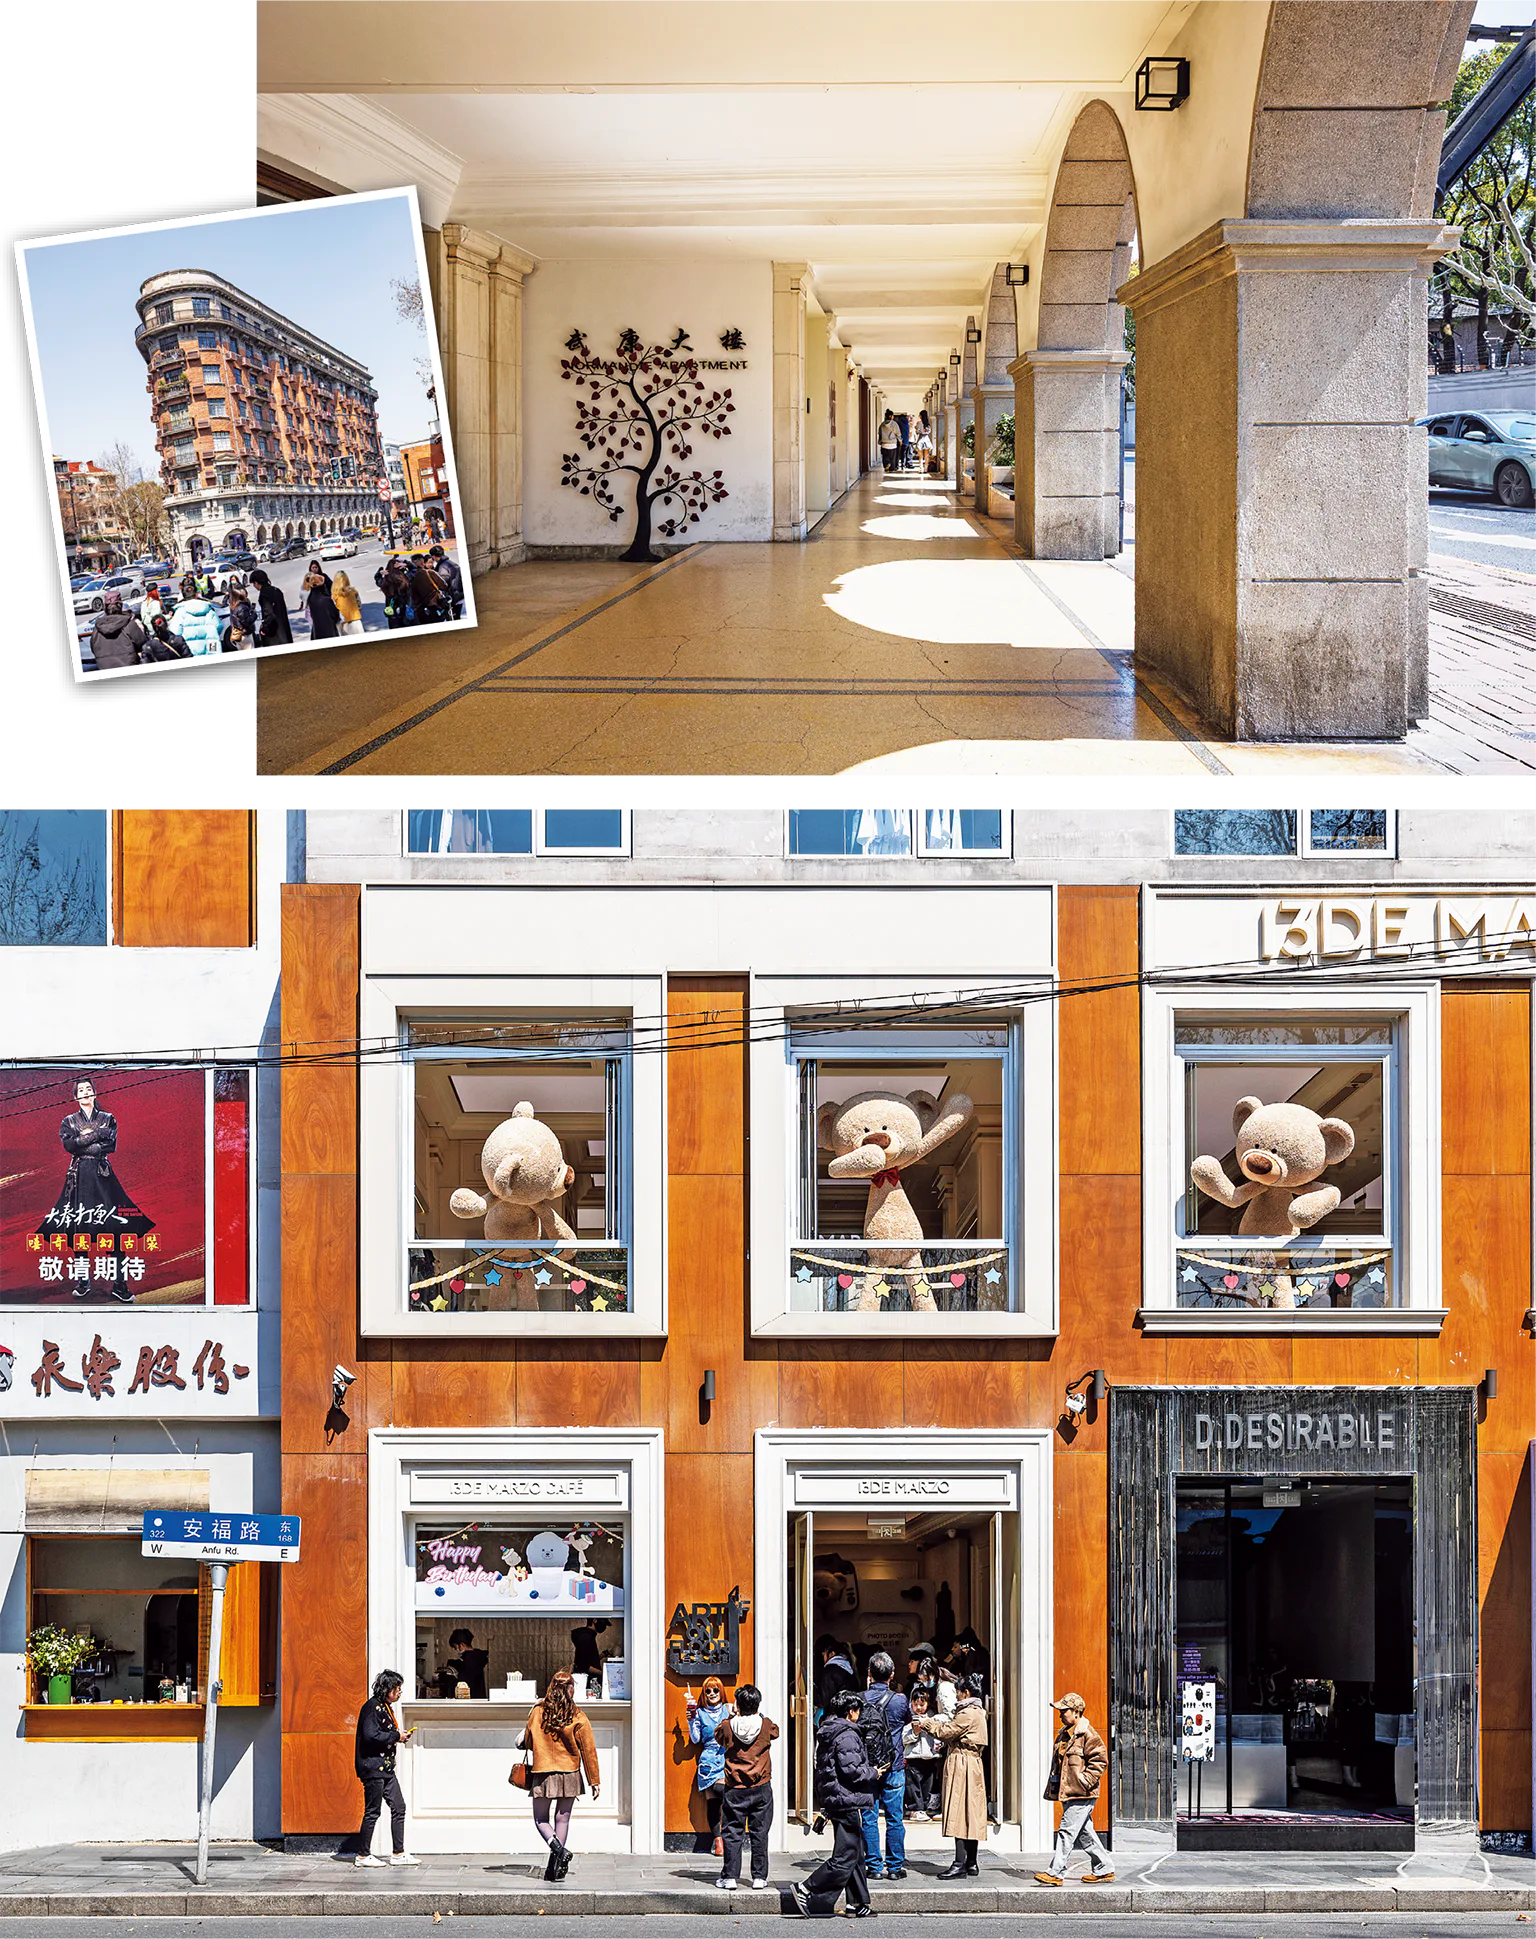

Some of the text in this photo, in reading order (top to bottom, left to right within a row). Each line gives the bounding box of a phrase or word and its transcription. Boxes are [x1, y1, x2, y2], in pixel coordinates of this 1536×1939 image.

[567, 360, 748, 371] ORMANDE APARTMENT
[38, 1256, 146, 1281] 敬请期待
[1195, 1412, 1396, 1450] D.DESIRABLE
[487, 1482, 541, 1495] MARZO
[546, 1478, 584, 1495] CAFÉ
[895, 1481, 949, 1494] MARZO
[183, 1518, 261, 1541] 安福路
[280, 1521, 292, 1533] 东
[149, 1530, 165, 1539] 322
[277, 1535, 293, 1543] 168
[150, 1544, 163, 1554] W
[201, 1546, 240, 1556] Anfu Rd.
[280, 1549, 288, 1559] E
[427, 1540, 482, 1564] Happy
[424, 1564, 500, 1587] Birthday
[669, 1603, 729, 1626] ART
[686, 1625, 713, 1641] ON
